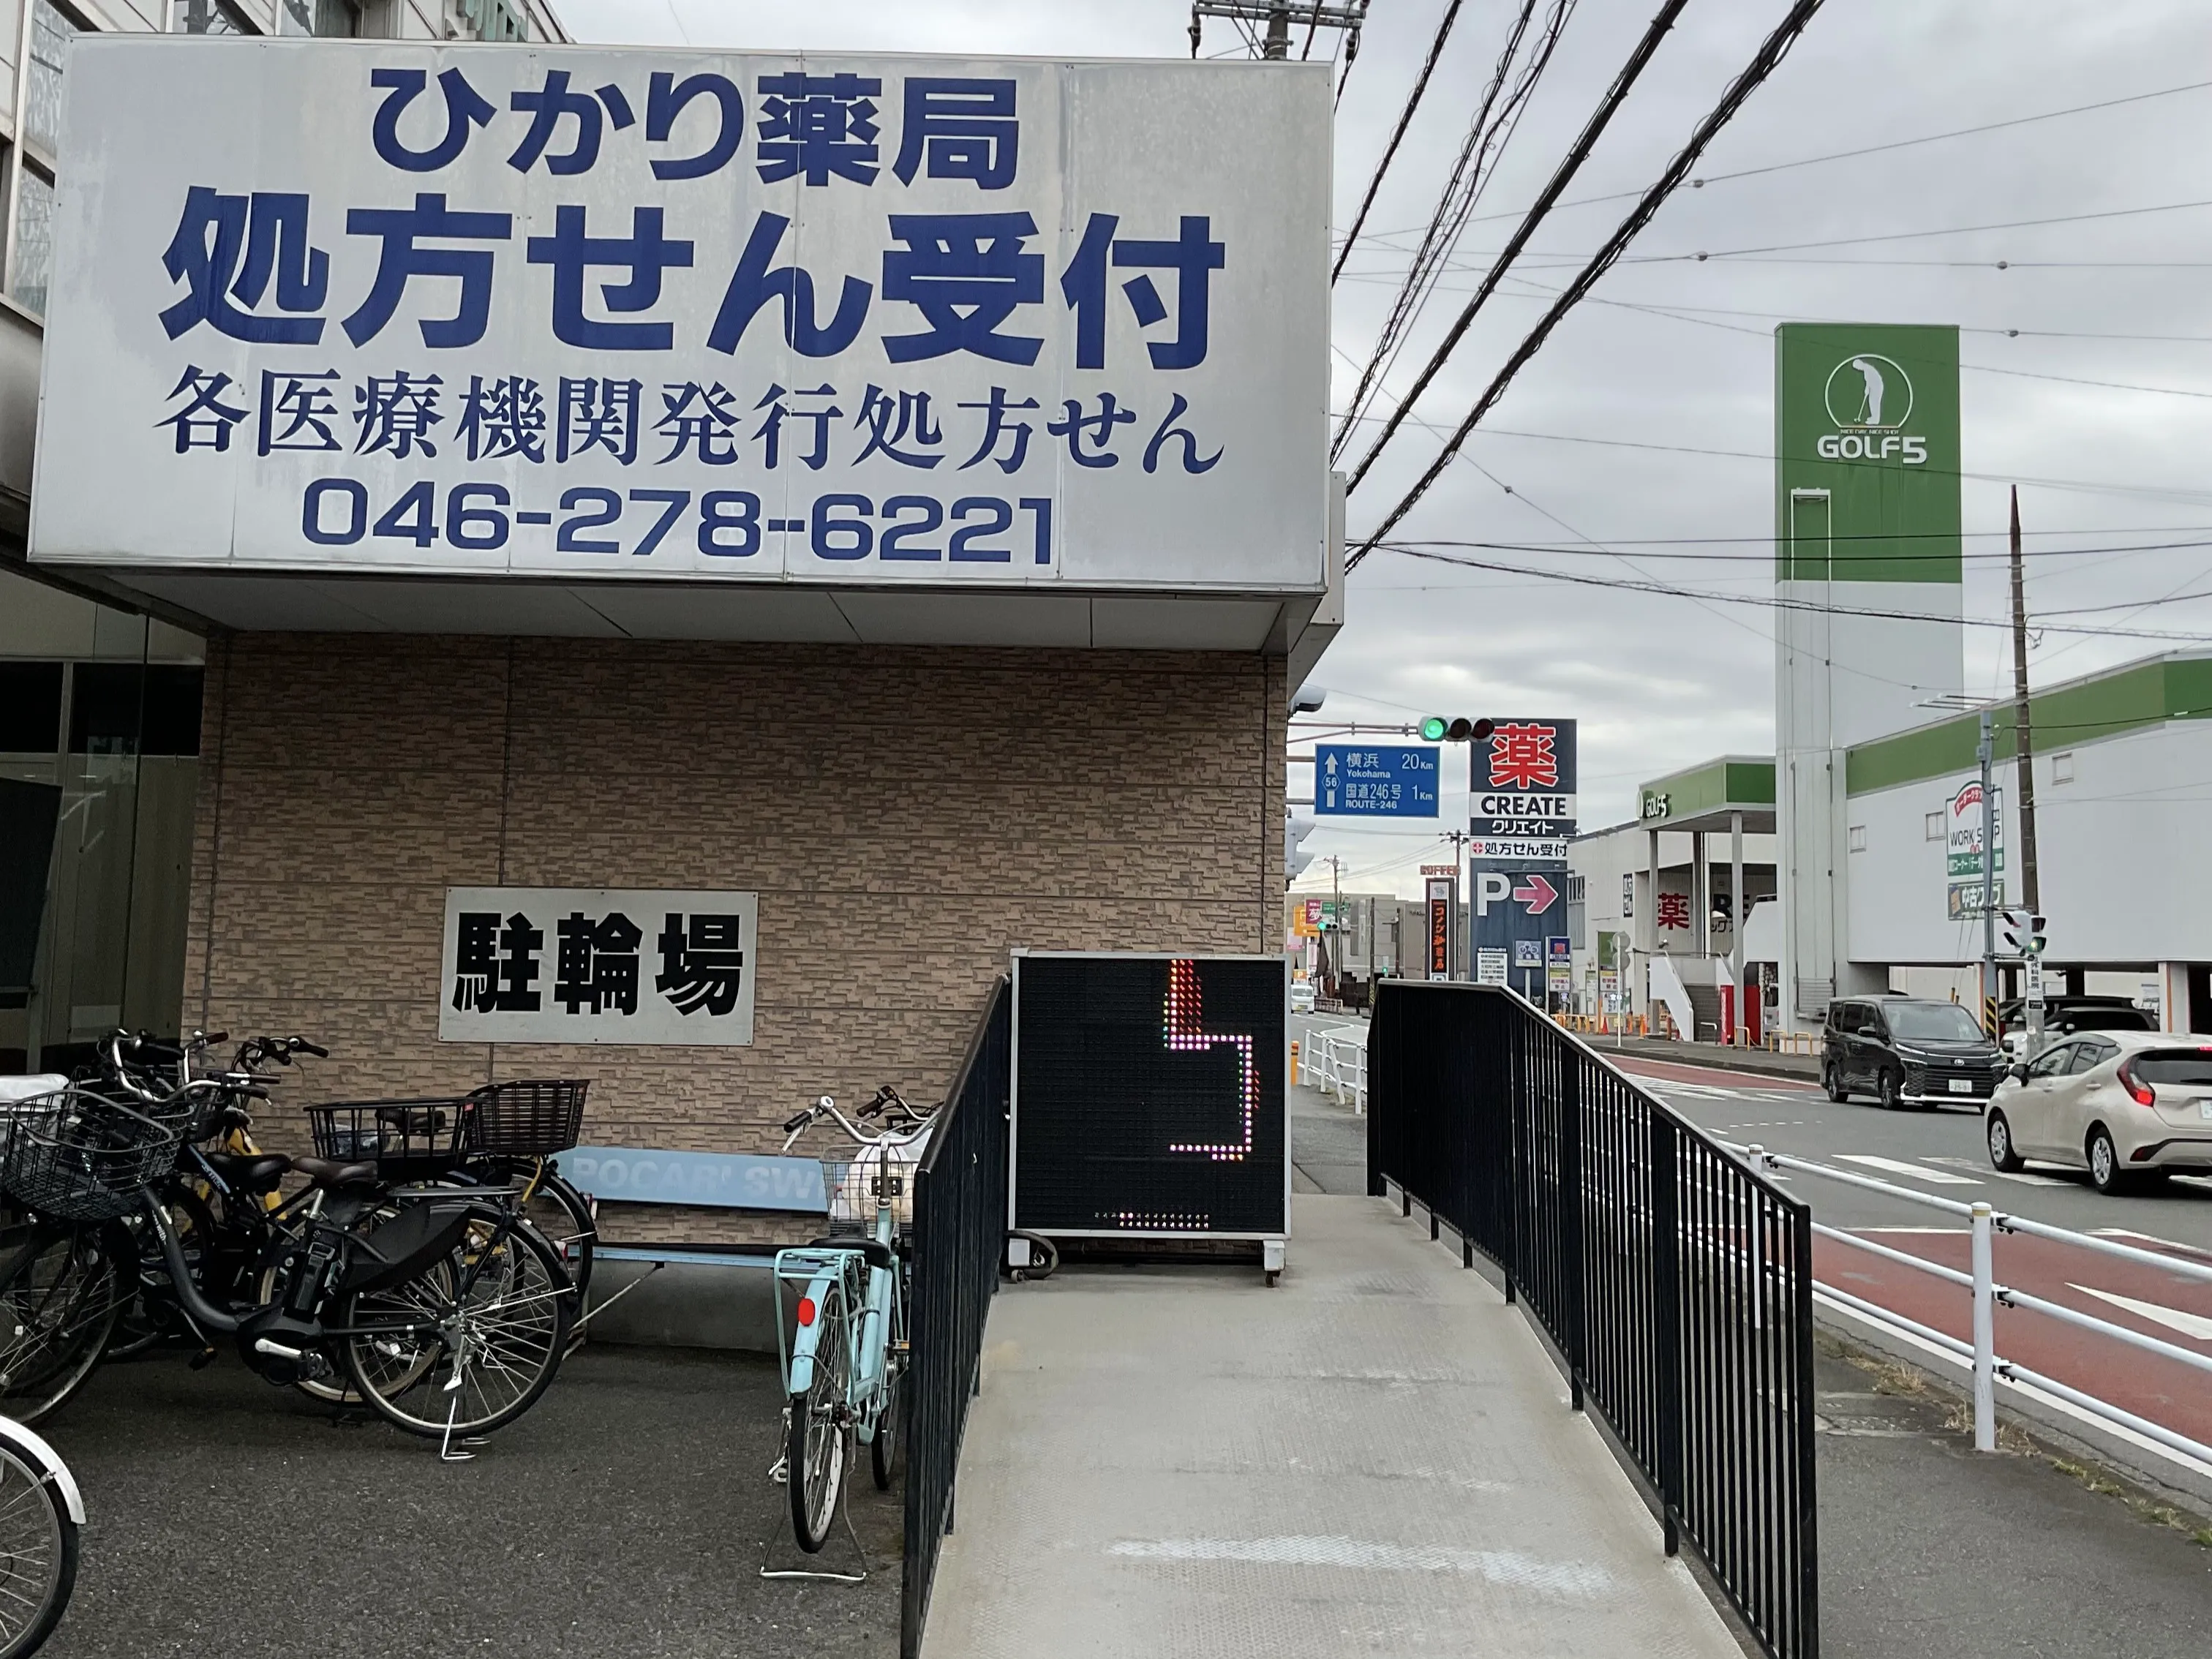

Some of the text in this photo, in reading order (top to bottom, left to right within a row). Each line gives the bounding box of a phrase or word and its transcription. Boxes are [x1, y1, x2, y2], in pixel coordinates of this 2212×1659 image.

[370, 67, 1020, 189] ひかり薬局
[158, 185, 1225, 369] 処方せん受付
[154, 364, 1224, 475] 各医療機関発行処方せん
[1817, 434, 1927, 464] GOLF5
[302, 478, 1053, 565] 046-278-6221
[1346, 752, 1379, 768] 横浜
[1489, 723, 1559, 789] 薬
[1325, 778, 1337, 787] 56
[1346, 770, 1391, 778] Yokohama
[1346, 783, 1402, 800] 国道246号
[1345, 800, 1397, 809] ROUTE-246
[1481, 795, 1566, 816] CREATE
[1646, 794, 1667, 818] GOLF5
[1491, 819, 1554, 835] クリエイト
[1950, 825, 2000, 846] WORK SP
[1485, 842, 1567, 857] 処方せん受付
[1477, 873, 1511, 917] P
[1658, 893, 1689, 930] 薬
[451, 911, 743, 1016] 駐輪場
